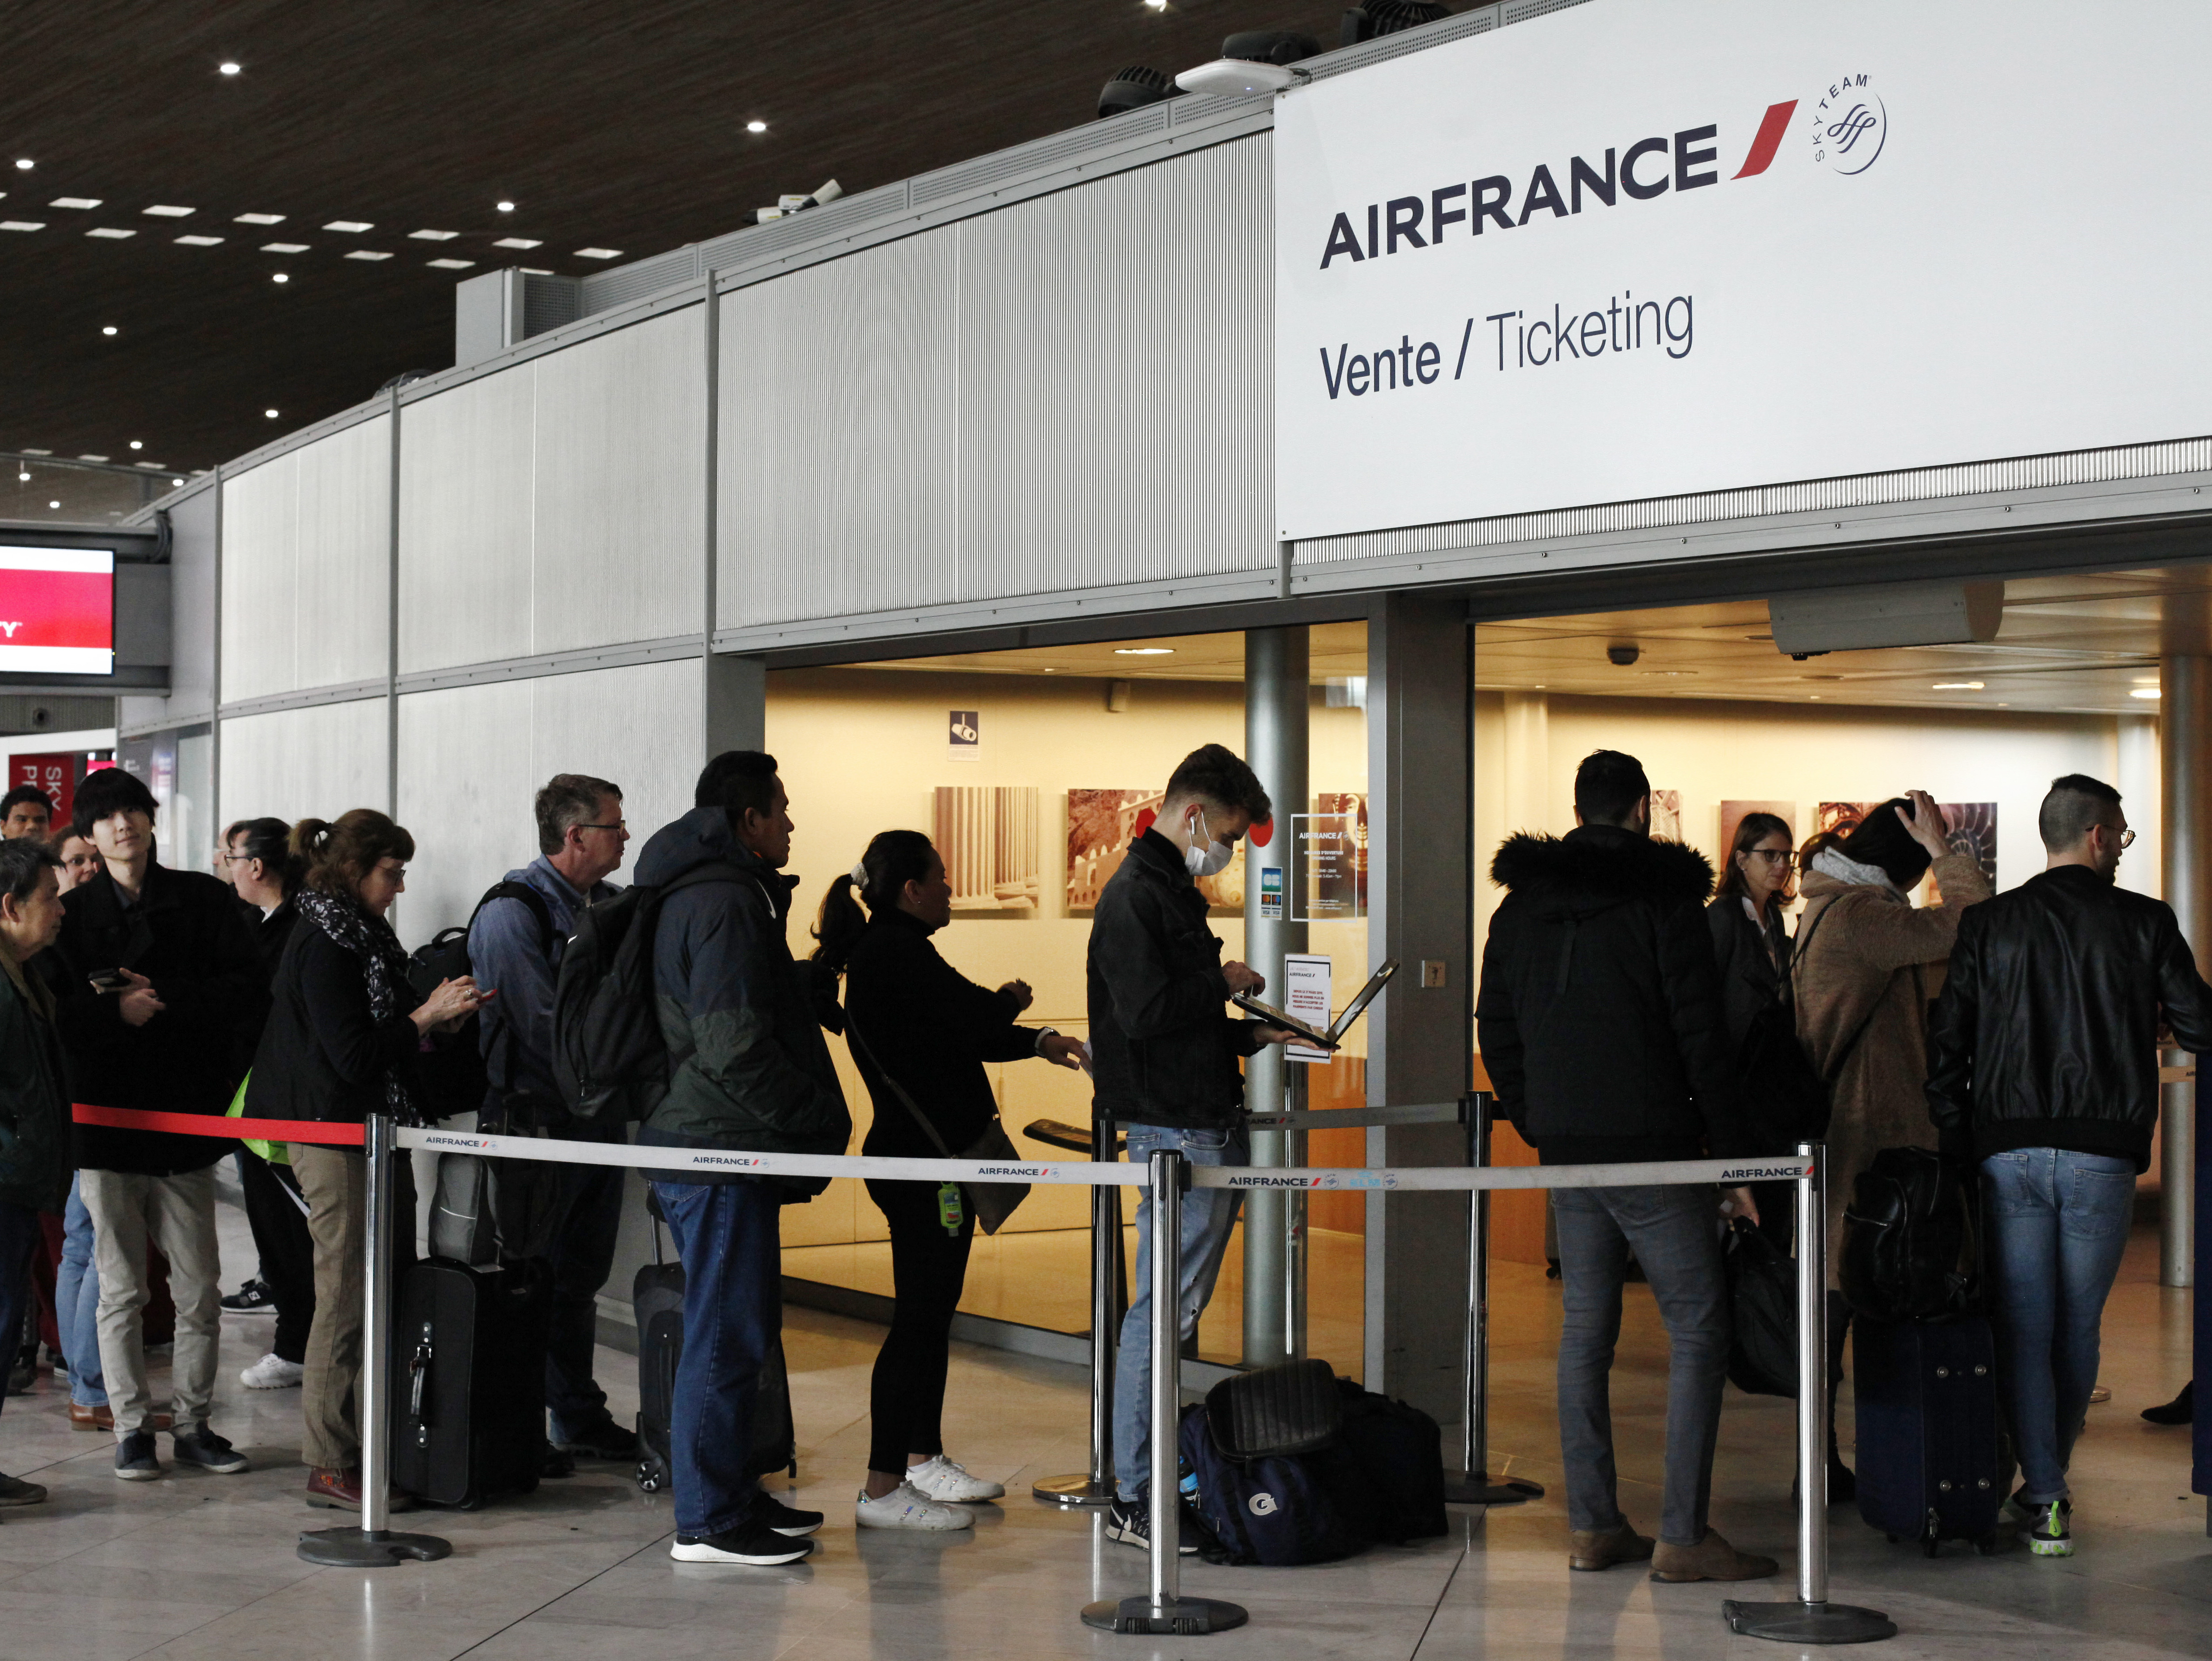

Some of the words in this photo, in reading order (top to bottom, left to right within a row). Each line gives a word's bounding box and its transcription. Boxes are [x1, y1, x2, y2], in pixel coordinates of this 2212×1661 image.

[1812, 74, 1867, 162] SKYTEAM
[1320, 123, 1718, 270] AIRFRANCE
[1320, 335, 1440, 400] Vente
[1454, 318, 1474, 380] /
[1486, 290, 1693, 371] Ticketing
[0, 621, 17, 637] Y
[426, 1136, 479, 1147] AIRFRANCE
[693, 1156, 749, 1166] AIRFRANCE
[1721, 1167, 1802, 1179] AIRFRANCE
[1228, 1176, 1308, 1187] AIRFRANCE
[1350, 1178, 1380, 1187] KLM
[1249, 1493, 1278, 1516] G
